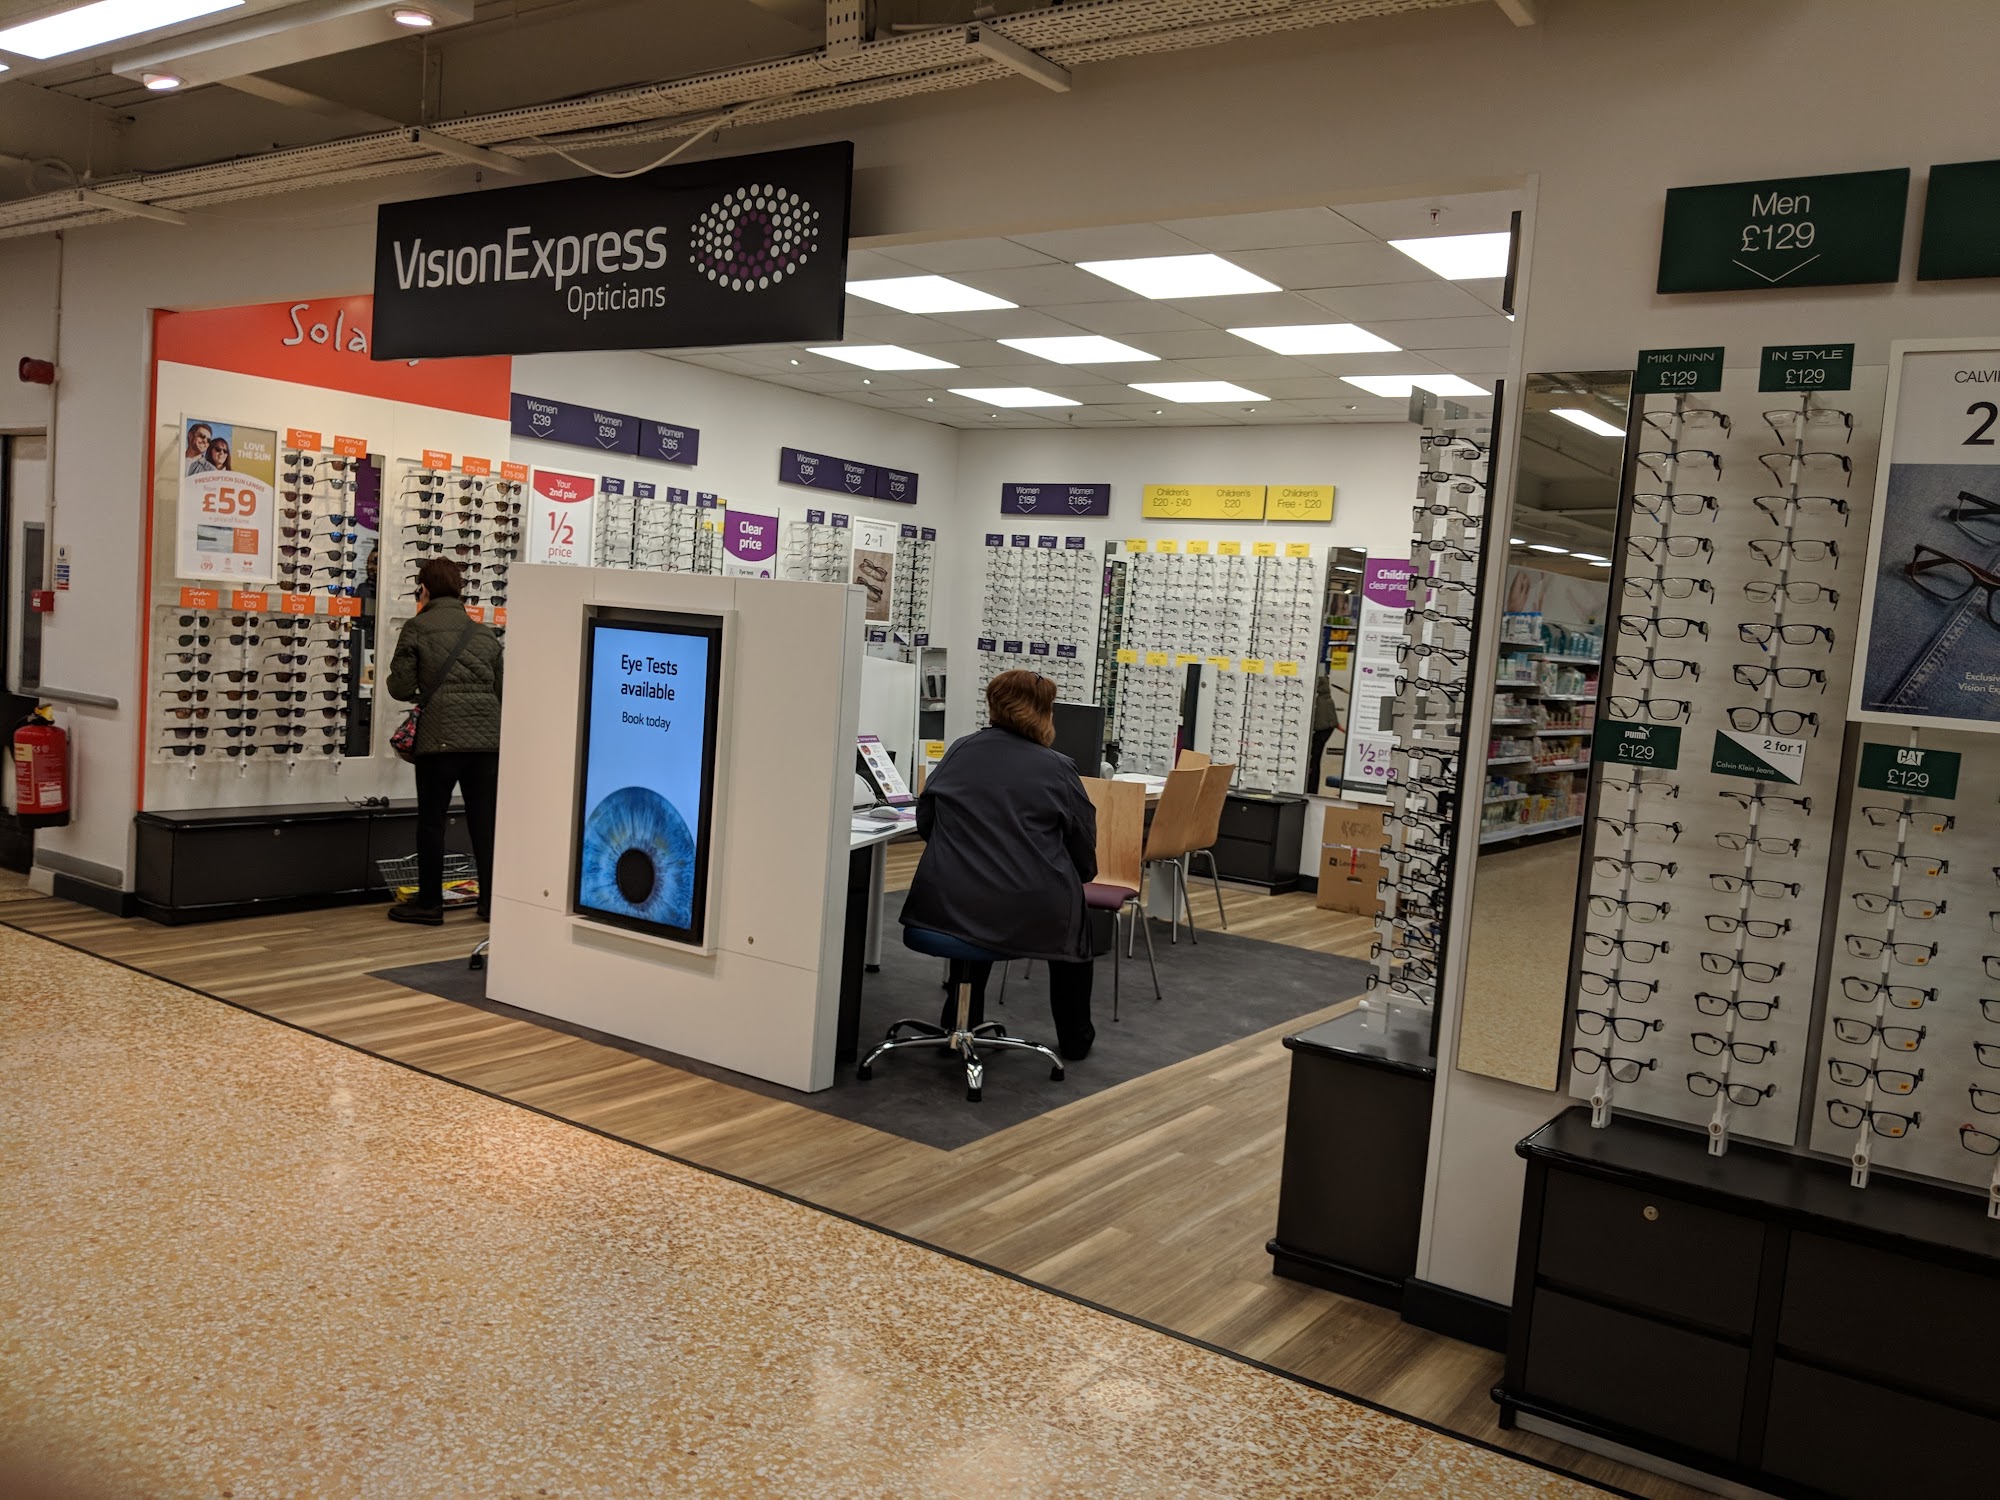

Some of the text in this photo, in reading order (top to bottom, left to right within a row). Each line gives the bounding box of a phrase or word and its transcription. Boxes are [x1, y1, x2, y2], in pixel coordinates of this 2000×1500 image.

[1752, 191, 1810, 217] Men
[1740, 222, 1816, 252] £129
[567, 283, 666, 320] Opticians
[282, 304, 368, 353] Sola
[1647, 352, 1715, 364] MIKI NINN
[1771, 350, 1844, 361] IN STYLE
[1660, 370, 1698, 386] £129
[1785, 368, 1825, 384] £129
[527, 400, 558, 415] Women
[532, 413, 551, 427] £39
[593, 413, 622, 427] Women
[1961, 401, 1998, 445] 2
[598, 426, 616, 439] £59
[657, 425, 684, 439] Women
[244, 442, 265, 452] LOVE
[662, 438, 678, 450] £85
[237, 449, 271, 461] THE SUN
[797, 453, 819, 466] Women
[800, 464, 814, 476] £99
[844, 463, 865, 475] Women
[195, 476, 233, 484] PRESCRIPTION
[845, 473, 861, 485] £129
[889, 472, 908, 483] Women
[556, 479, 571, 489] Your
[890, 481, 905, 493] £129
[548, 488, 577, 500] 2nd pair
[1069, 487, 1094, 495] Women
[1156, 488, 1190, 497] Children's
[1216, 489, 1251, 498] Children's
[1282, 489, 1318, 498] Children's
[202, 487, 257, 517] £59
[1018, 495, 1036, 504] £159
[1068, 496, 1093, 505] £185+
[1152, 498, 1169, 507] £20
[1176, 498, 1192, 507] £40
[1224, 499, 1241, 508] £20
[1277, 499, 1296, 509] Free
[1304, 499, 1322, 509] £20
[739, 520, 763, 536] Clear
[739, 536, 762, 551] price
[865, 533, 870, 545] 2
[879, 535, 882, 547] 1
[548, 546, 572, 558] price
[1369, 581, 1387, 590] clear
[621, 654, 678, 676] Eye Tests
[621, 681, 675, 701] available
[1958, 683, 1985, 692] Vision
[622, 711, 671, 732] Book today
[1625, 731, 1647, 739] PUMA
[1618, 743, 1654, 760] £129
[1763, 740, 1802, 753] 2 for 1
[1896, 749, 1925, 766] CAT
[1716, 760, 1775, 775] Calvin Klein Jeans
[1886, 768, 1930, 788] £129
